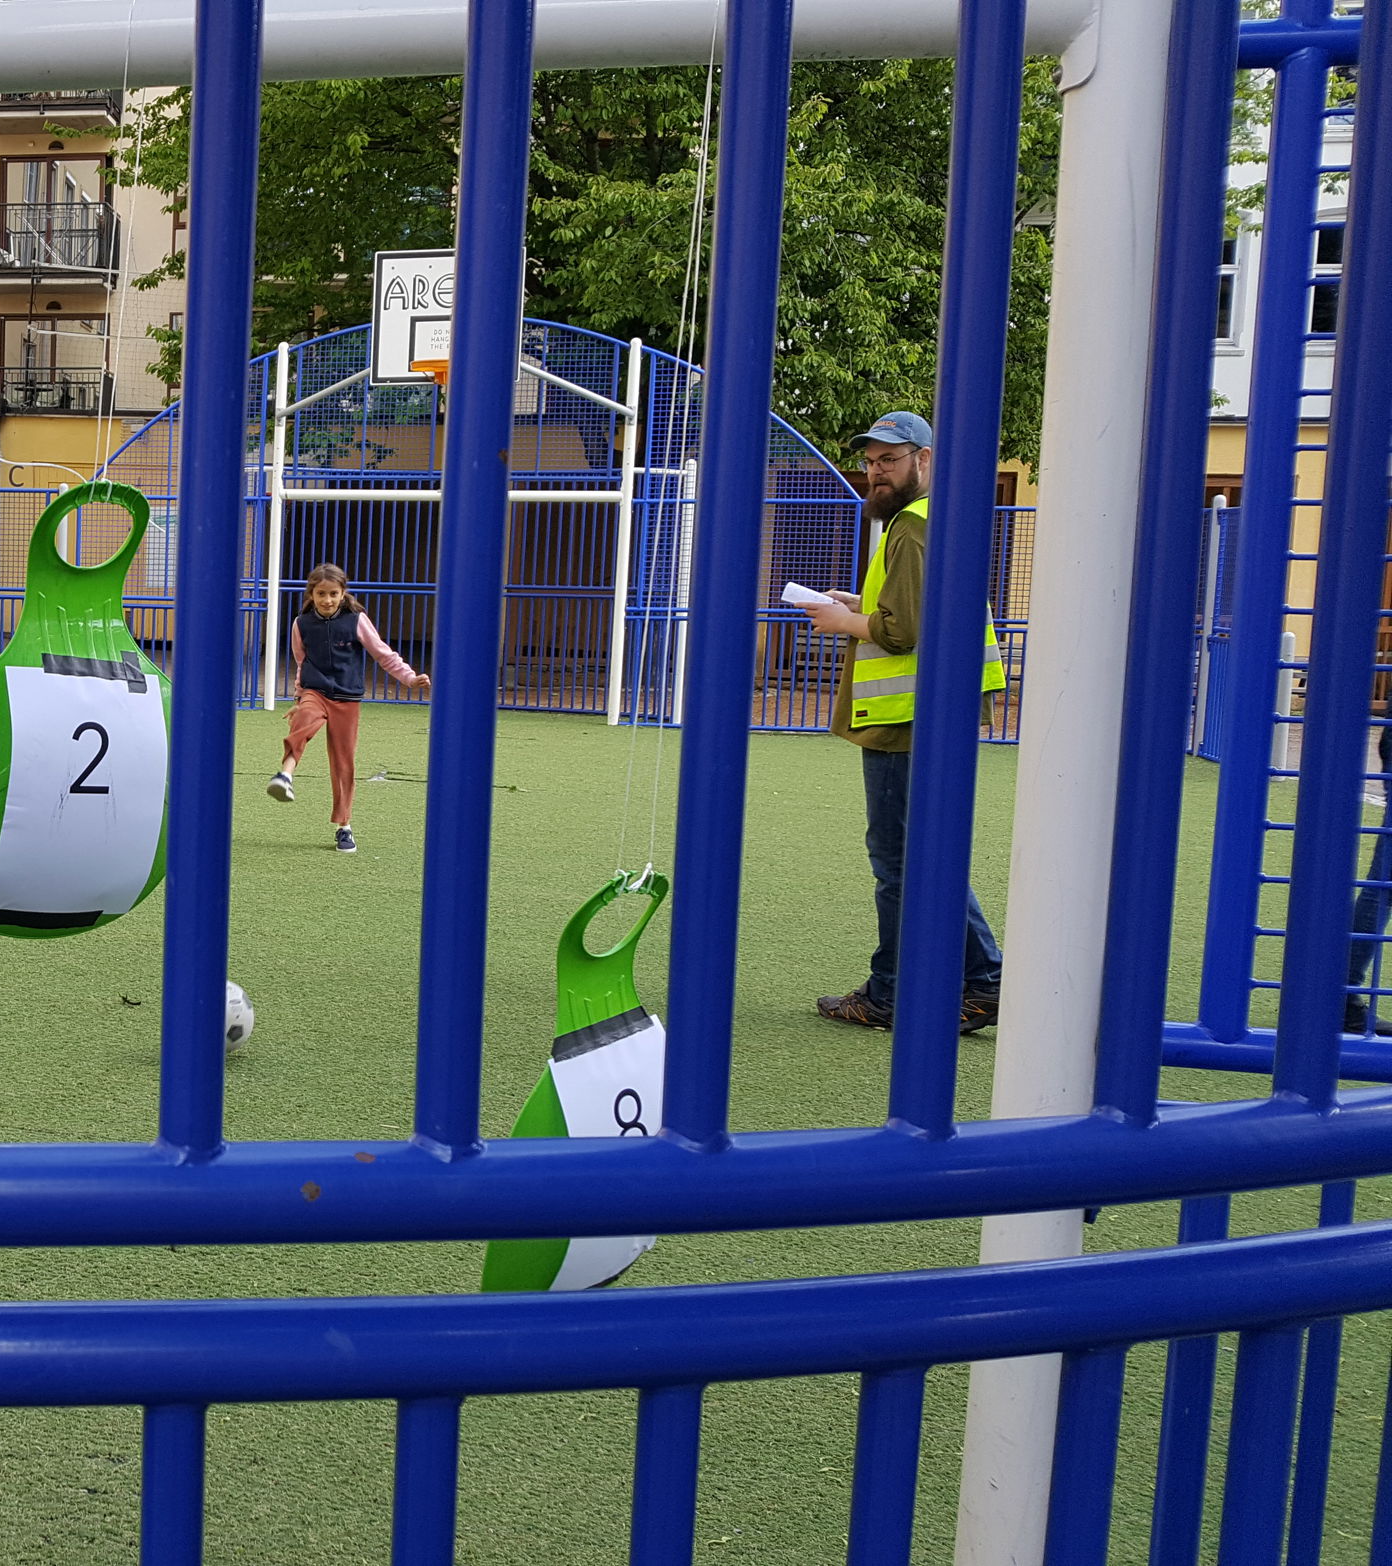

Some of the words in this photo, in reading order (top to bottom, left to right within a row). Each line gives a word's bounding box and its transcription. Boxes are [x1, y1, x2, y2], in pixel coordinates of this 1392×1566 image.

[8, 465, 25, 488] C
[69, 721, 110, 795] 2
[613, 1087, 648, 1138] 8
